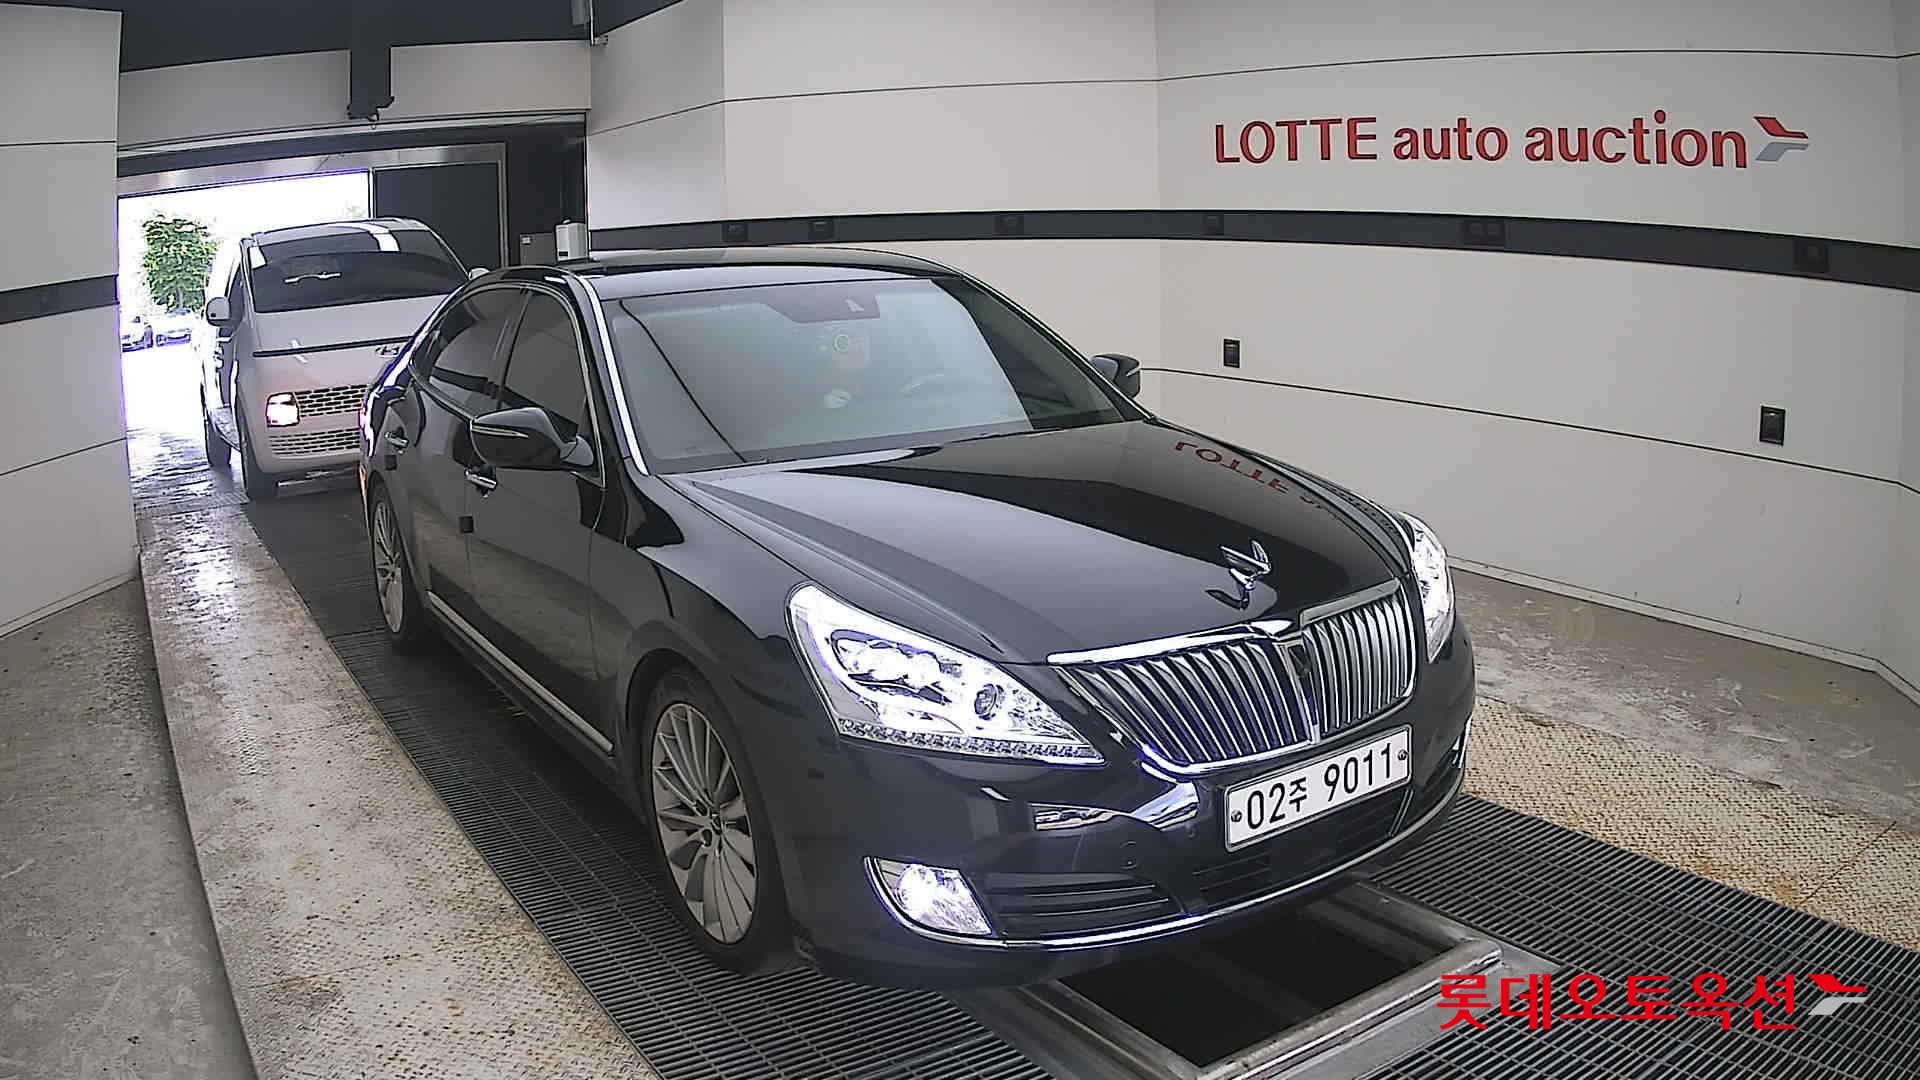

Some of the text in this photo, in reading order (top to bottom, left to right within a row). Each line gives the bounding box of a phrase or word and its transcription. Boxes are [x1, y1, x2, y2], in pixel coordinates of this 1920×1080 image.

[1215, 109, 1749, 169] LOTTE auto auction
[1247, 742, 1391, 830] 02주 9011
